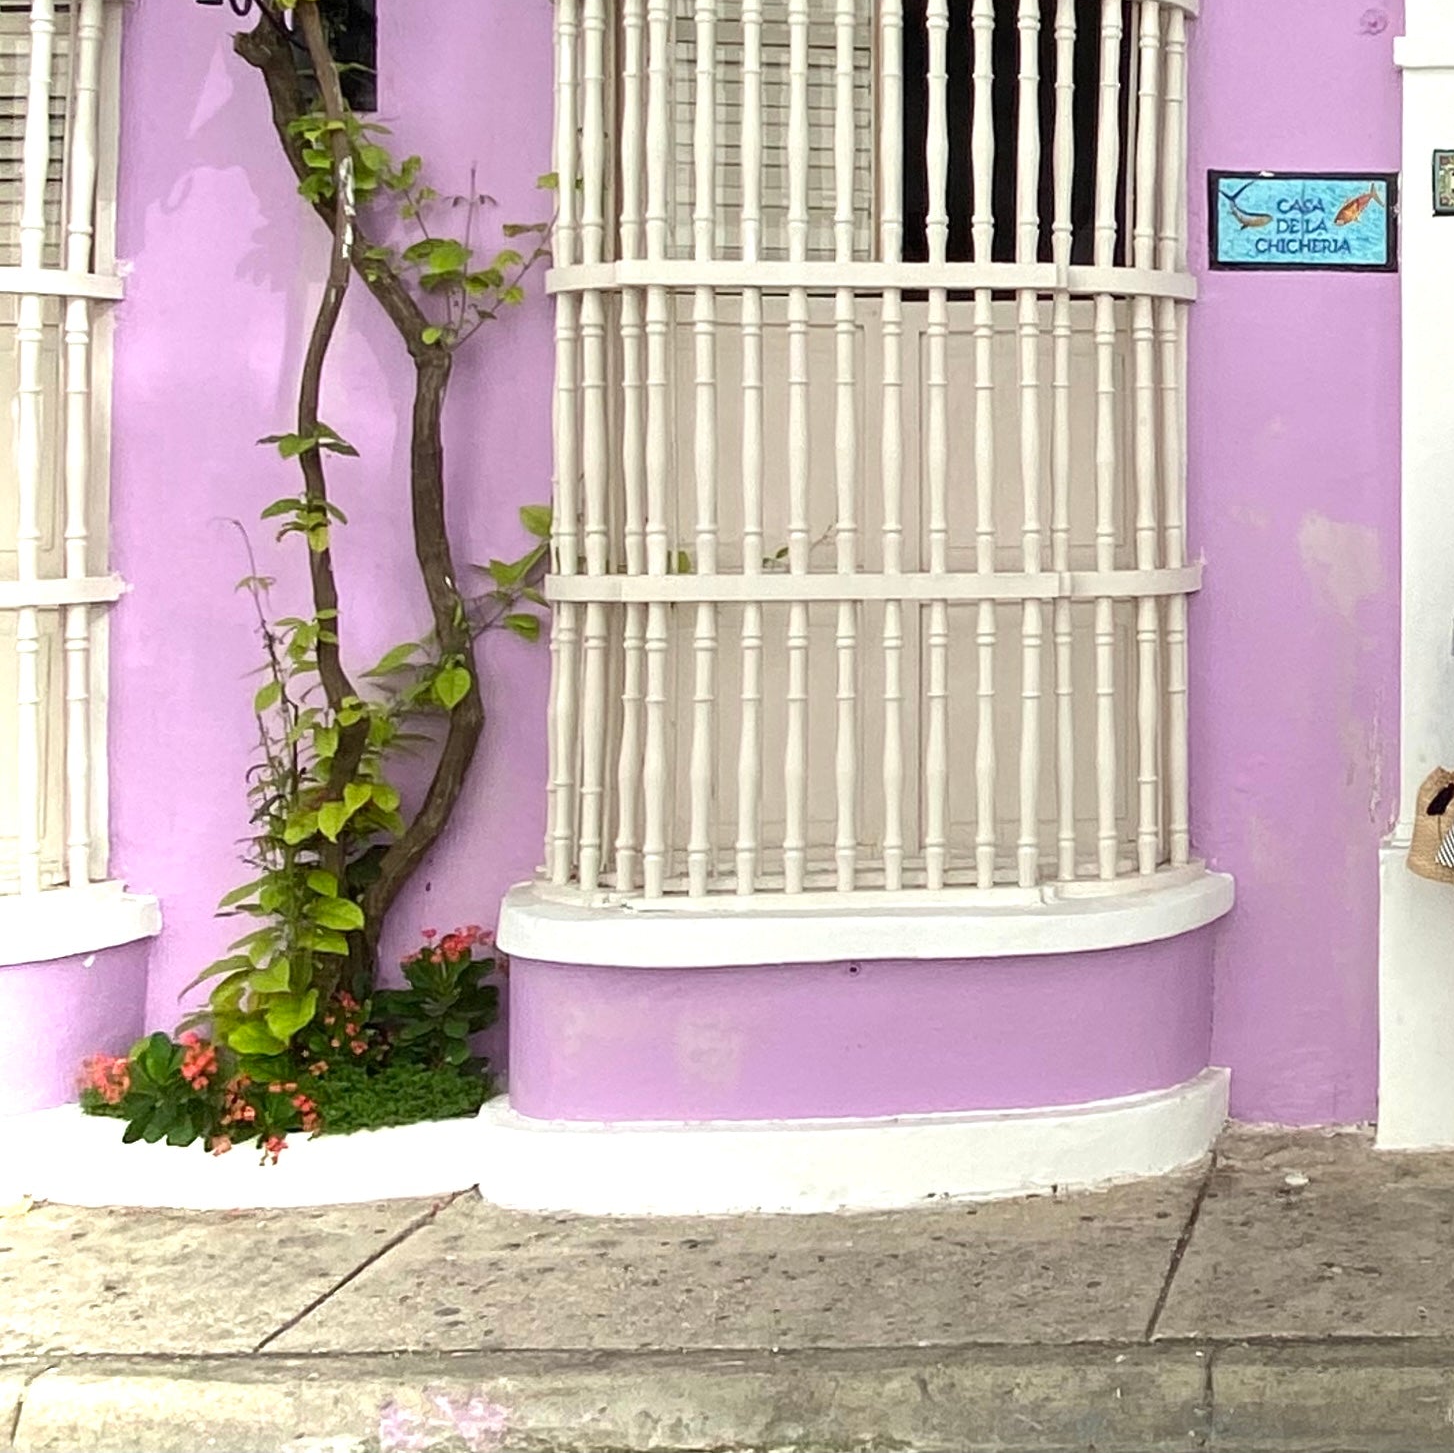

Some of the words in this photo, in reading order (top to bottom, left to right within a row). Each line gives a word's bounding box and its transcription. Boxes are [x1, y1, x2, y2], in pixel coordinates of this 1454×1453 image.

[1276, 198, 1325, 214] CASA
[1276, 218, 1300, 234] DE
[1304, 218, 1327, 234] LA
